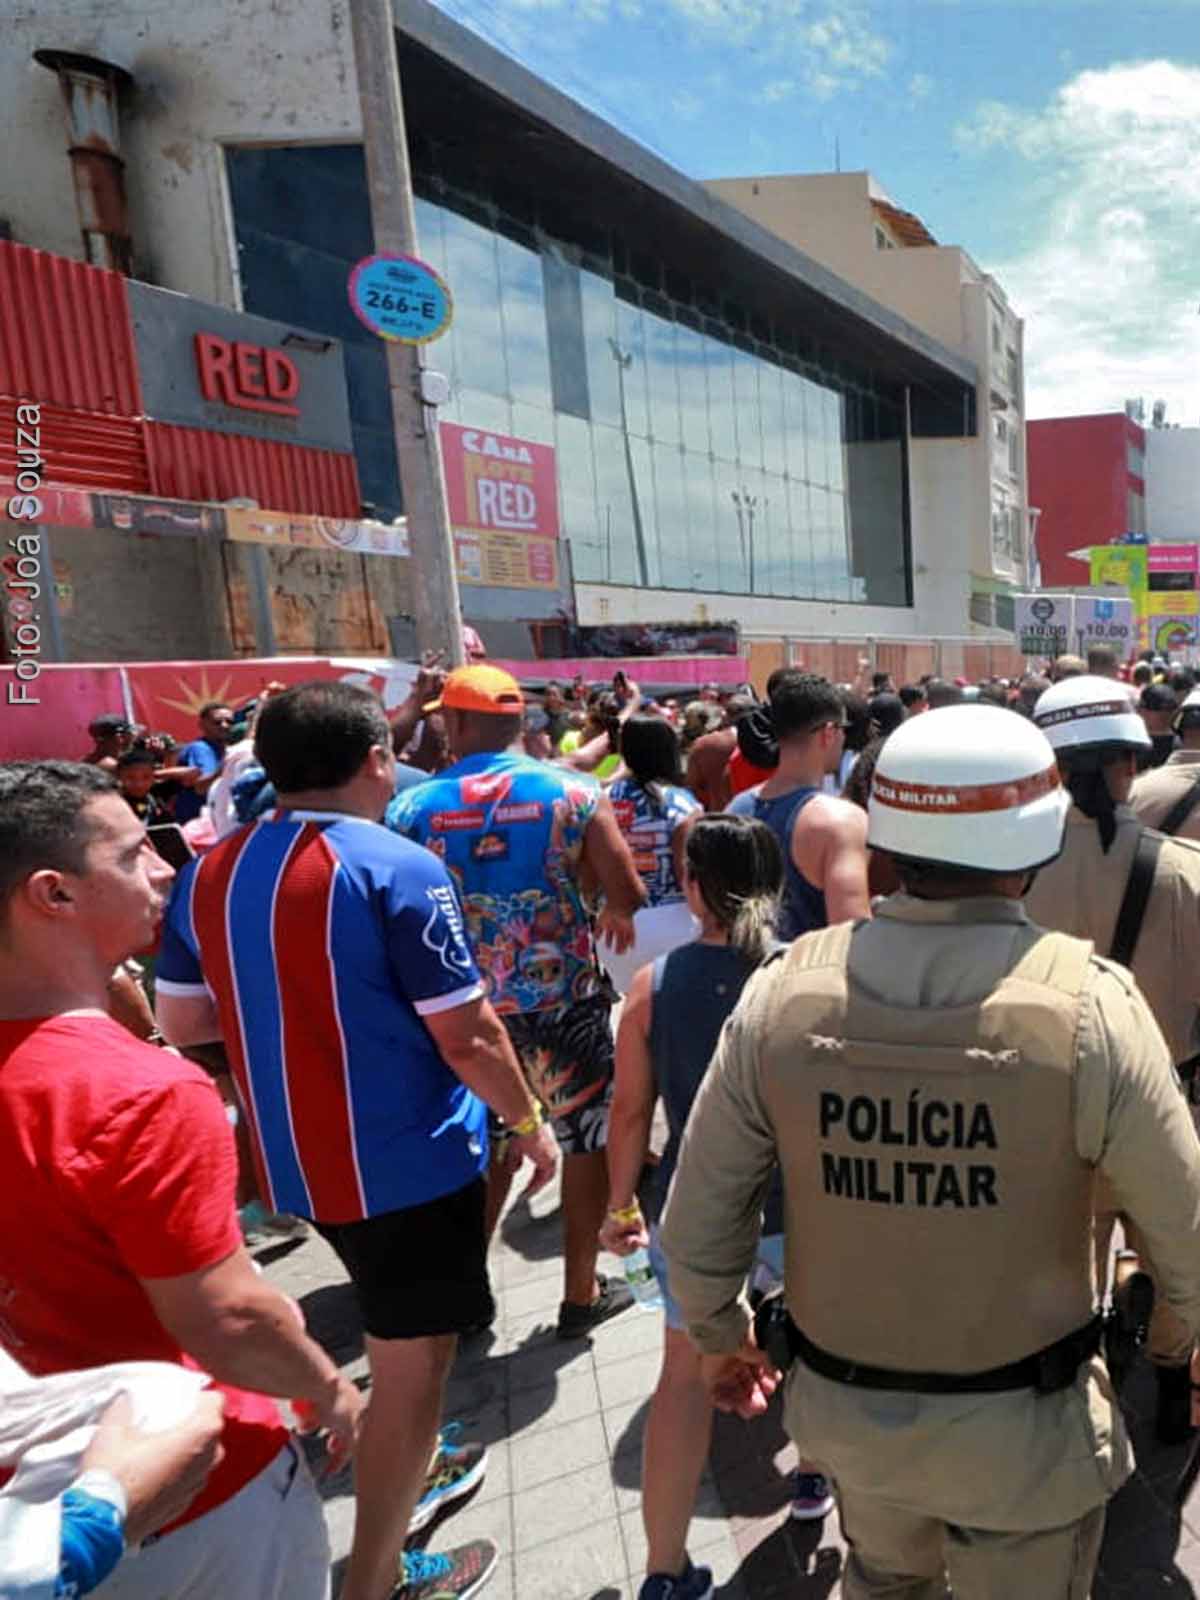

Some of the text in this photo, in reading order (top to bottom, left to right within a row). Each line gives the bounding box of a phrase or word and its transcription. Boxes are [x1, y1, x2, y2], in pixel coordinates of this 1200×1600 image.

[366, 290, 436, 320] 266-E
[194, 331, 301, 416] RED
[477, 478, 539, 529] RED
[899, 789, 958, 806] MILITAR
[819, 1088, 998, 1150] POLÍCIA
[821, 1152, 998, 1207] MILITAR
